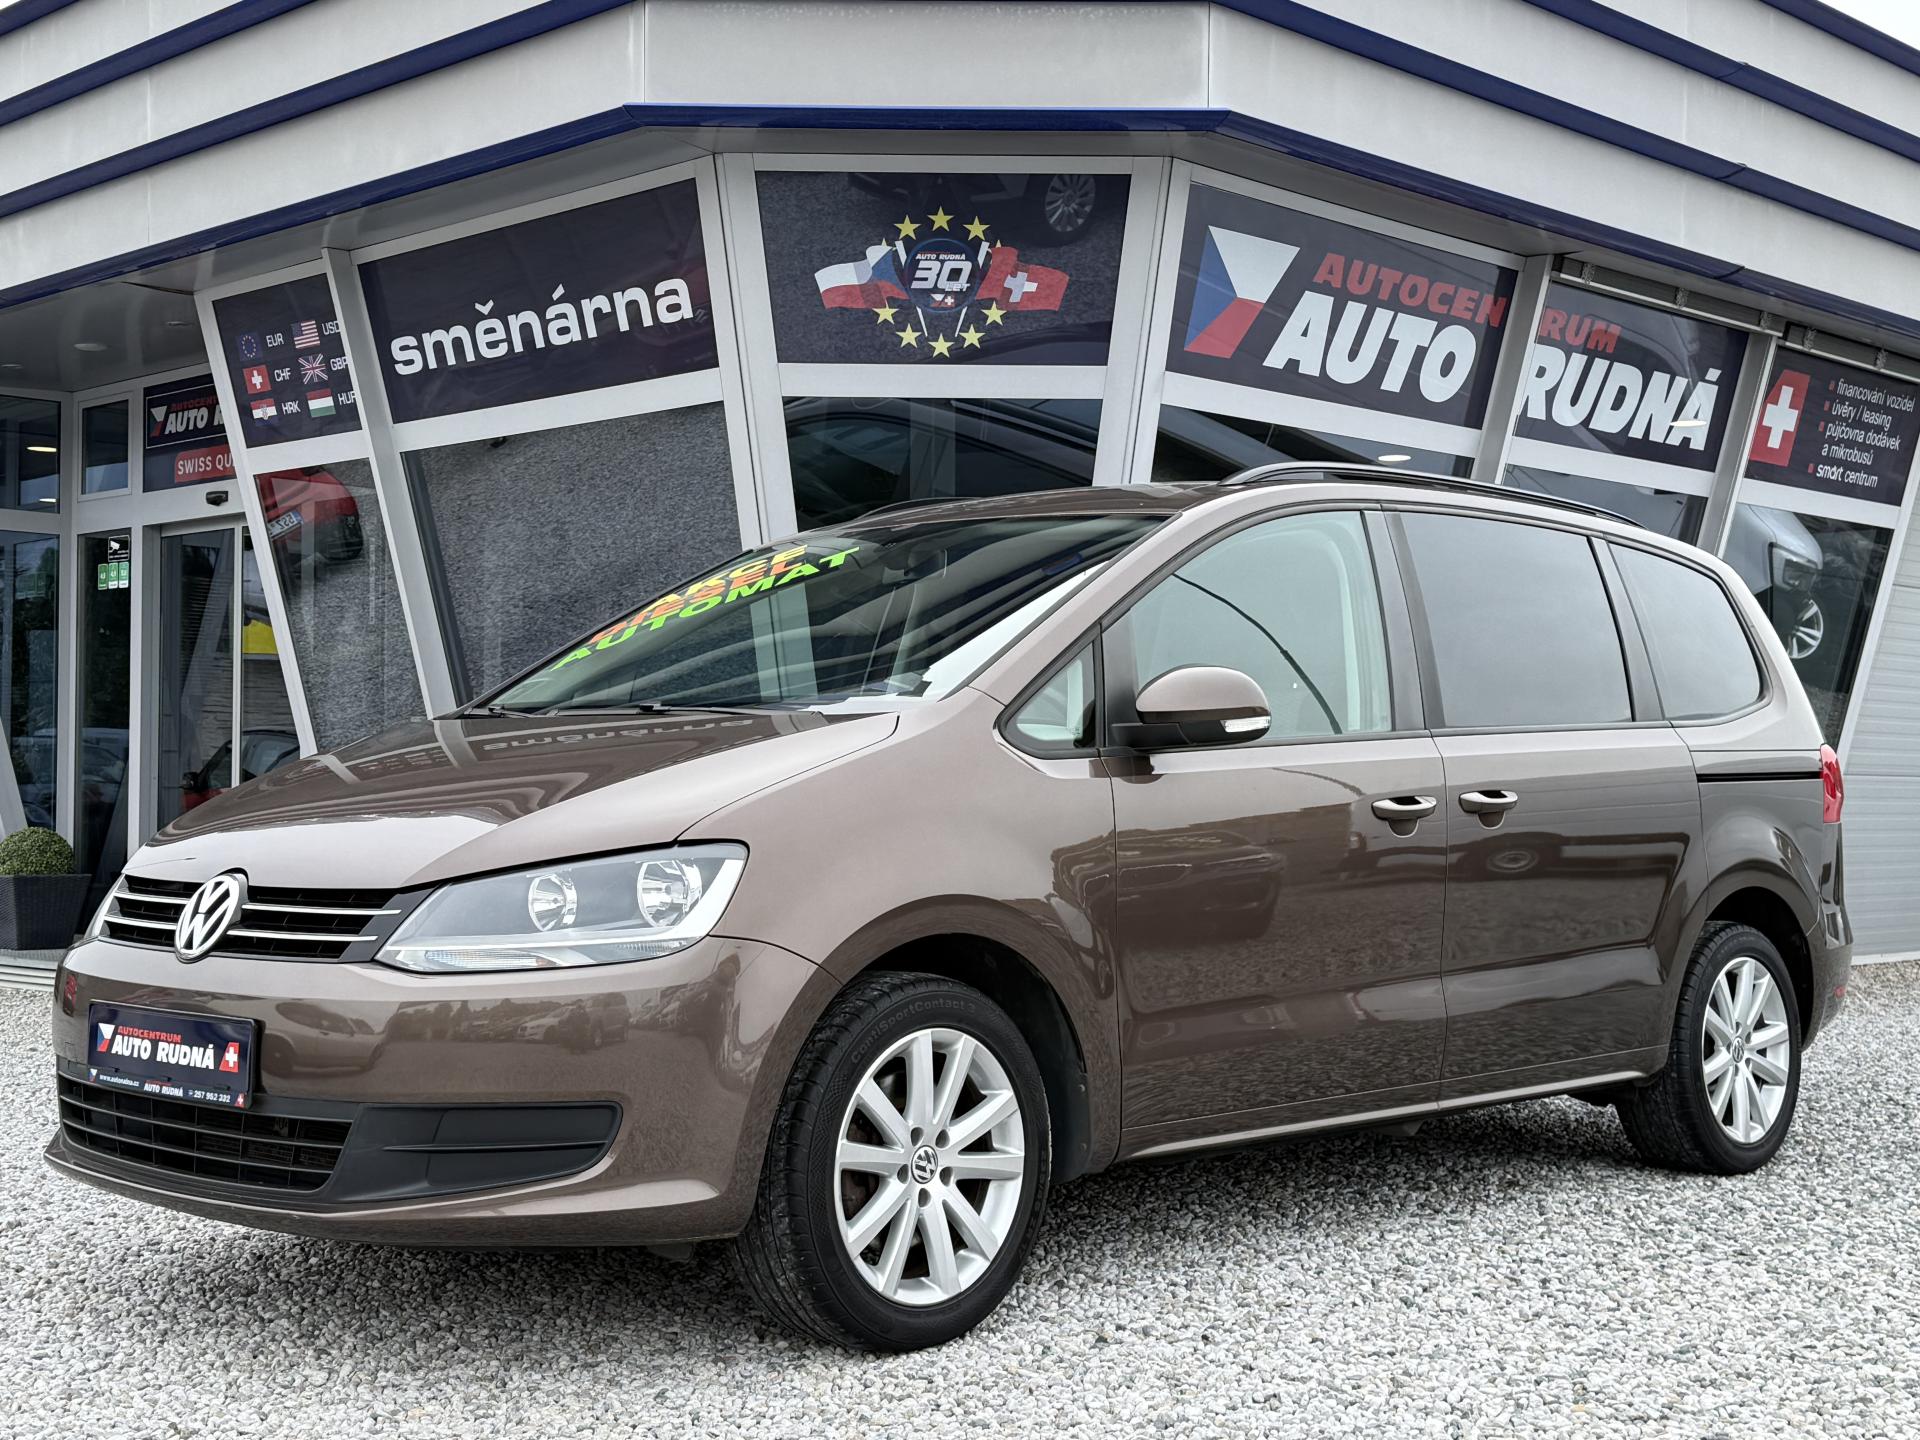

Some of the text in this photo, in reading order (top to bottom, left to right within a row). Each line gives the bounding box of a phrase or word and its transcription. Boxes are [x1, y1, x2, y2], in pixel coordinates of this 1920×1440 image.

[910, 260, 973, 289] 30
[1312, 252, 1507, 327] AUTOCEN
[266, 333, 285, 347] EUR
[321, 320, 341, 335] USD
[390, 278, 694, 375] směnárna
[1539, 307, 1623, 353] RUM
[274, 368, 291, 381] CHF
[330, 356, 348, 371] GBP
[1262, 290, 1722, 451] AUTO RUDNÁ
[281, 400, 301, 415] HRK
[1837, 378, 1915, 412] financování vozidel
[164, 406, 209, 435] AUTO
[1831, 399, 1857, 423] úvěry
[1862, 405, 1892, 431] leasing
[1825, 420, 1901, 451] půjčovna dodávek
[177, 456, 212, 475] SWISS
[1821, 443, 1874, 465] a mikrobusů
[1844, 469, 1878, 488] centrum
[550, 546, 860, 672] AUTOMAT
[117, 1025, 182, 1043] AUTOCENTRUM
[111, 1034, 215, 1070] AUTO RUDNÁ
[143, 1083, 161, 1093] AUTO
[161, 1086, 184, 1098] RUDNÁ
